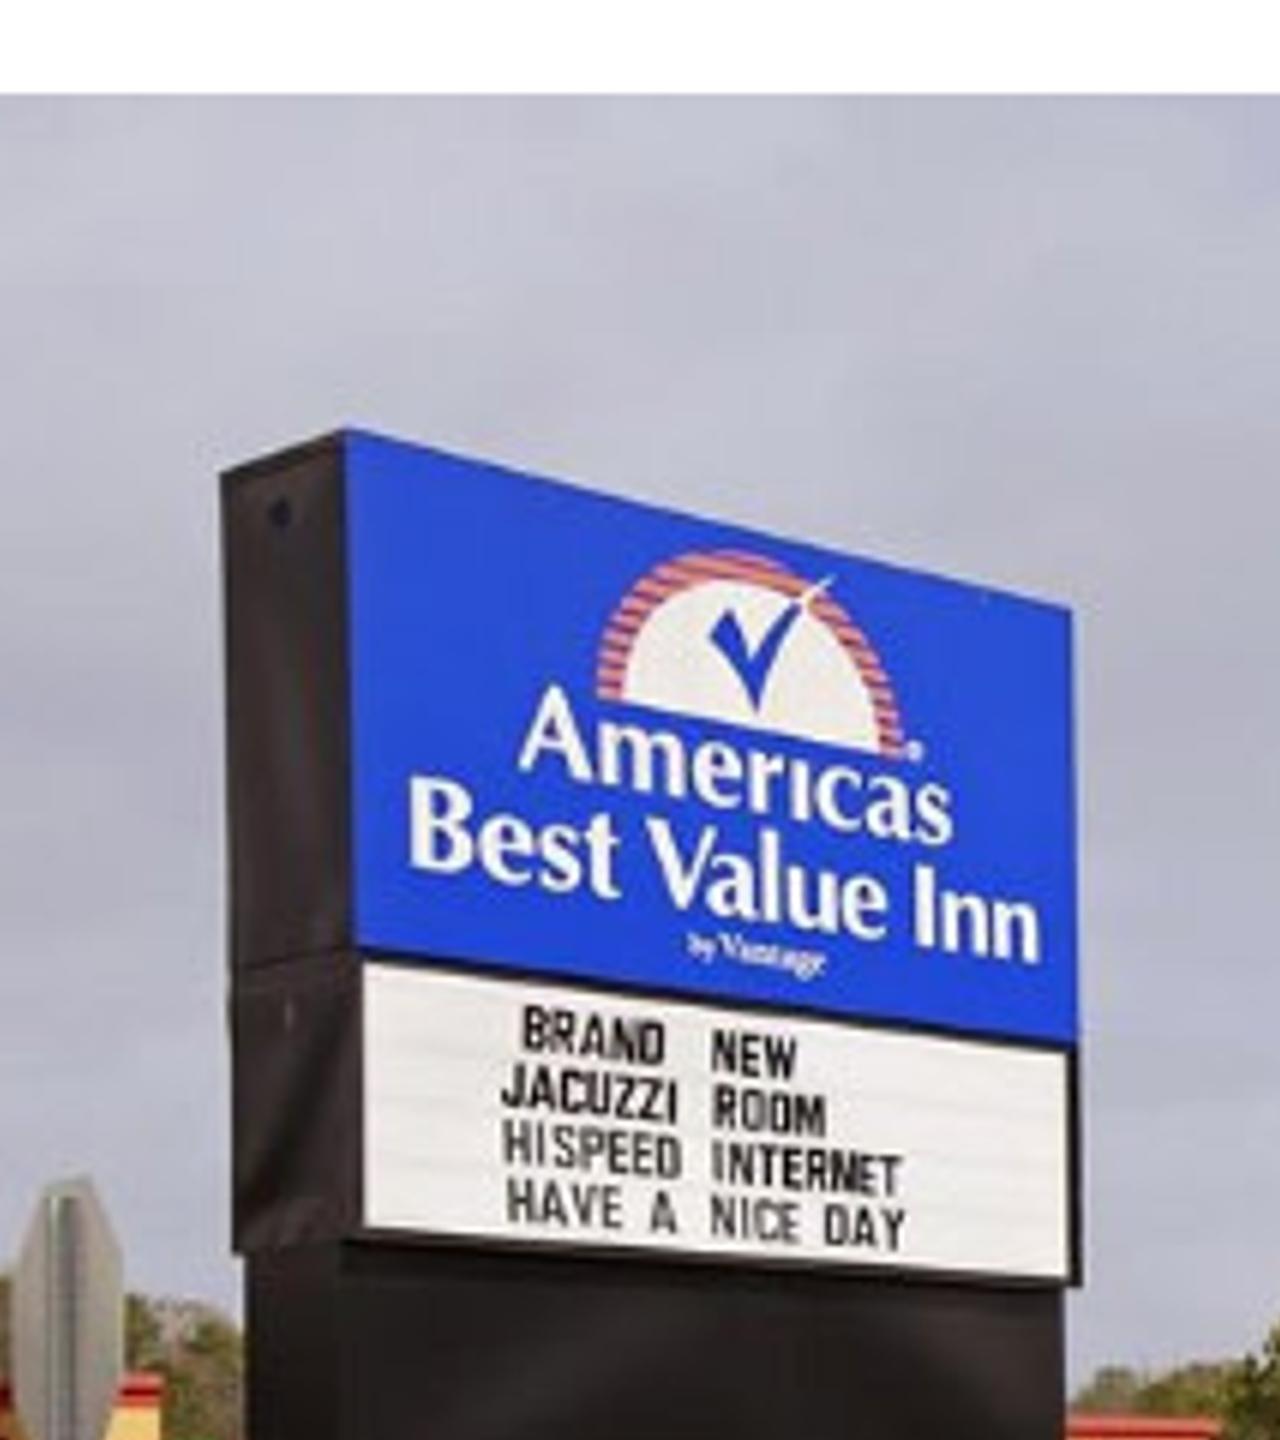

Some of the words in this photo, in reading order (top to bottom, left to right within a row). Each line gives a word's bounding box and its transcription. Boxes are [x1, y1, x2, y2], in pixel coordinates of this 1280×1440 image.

[518, 684, 953, 844] Americas
[409, 775, 622, 898] Best
[645, 816, 887, 940] Value
[914, 865, 1040, 964] Inn
[686, 932, 716, 963] by
[721, 933, 828, 979] Vantage
[522, 1005, 665, 1066] BRAND
[711, 1029, 797, 1079] NEW
[500, 1063, 678, 1124] JACUZZI
[711, 1085, 827, 1137] ROOM
[712, 1140, 902, 1196] INTERNET
[506, 1178, 623, 1229] HAVE
[648, 1191, 679, 1234] A
[710, 1195, 799, 1244] NICE
[823, 1206, 906, 1250] DAY
